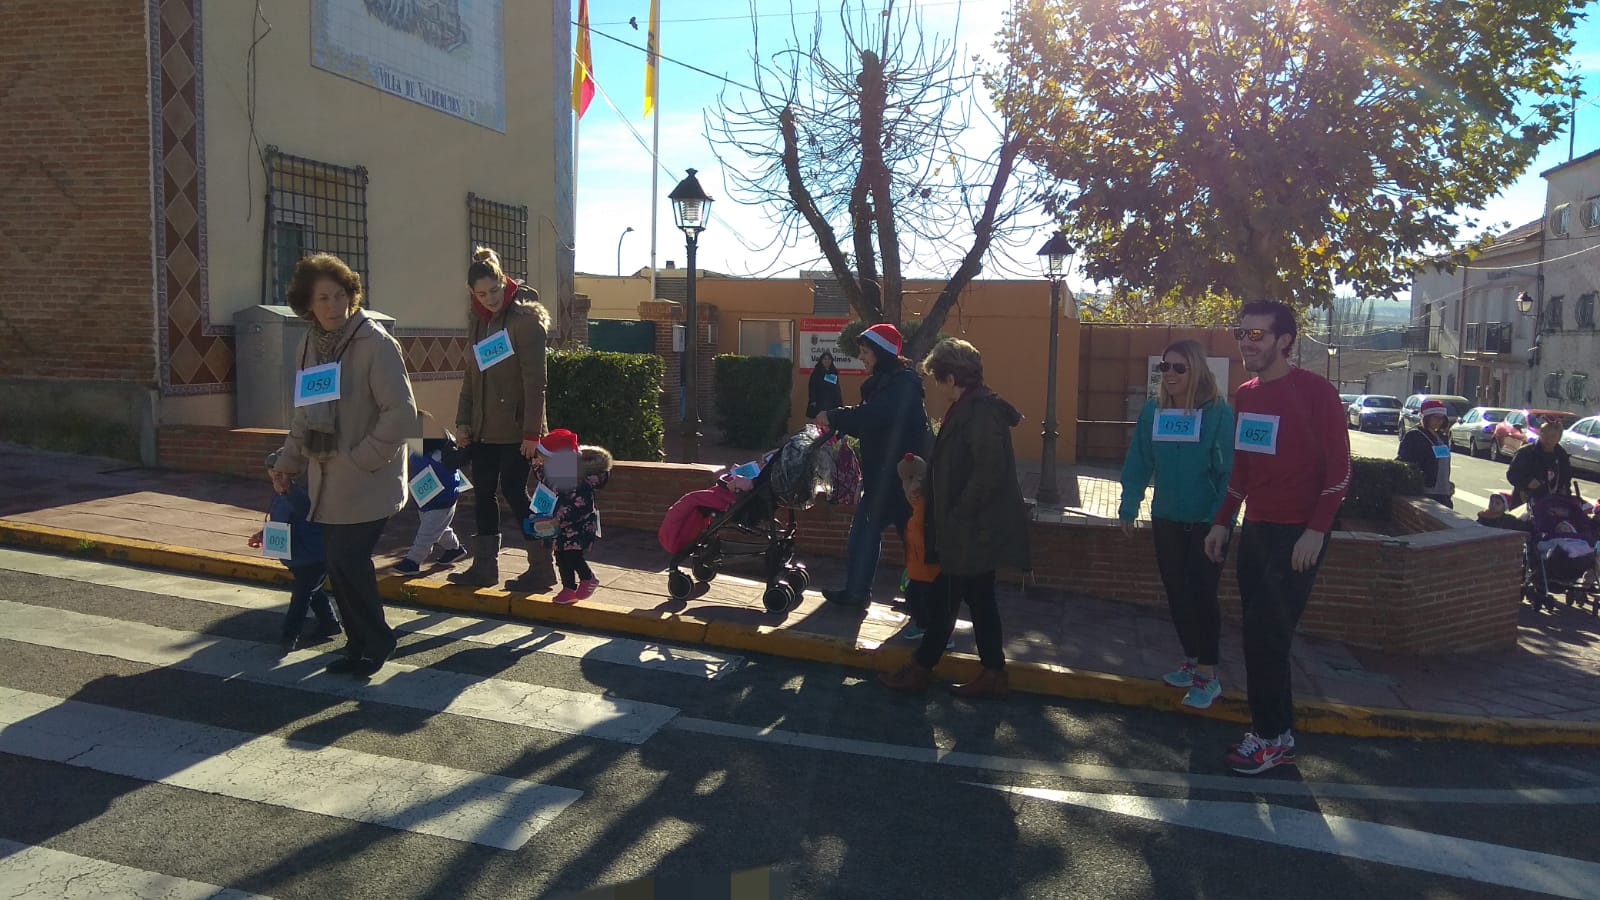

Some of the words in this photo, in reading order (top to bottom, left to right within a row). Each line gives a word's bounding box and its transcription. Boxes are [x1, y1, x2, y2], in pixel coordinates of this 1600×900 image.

[378, 66, 402, 94] VILLA
[485, 342, 504, 358] 043
[307, 377, 331, 392] 059
[1165, 421, 1190, 433] 053
[1245, 428, 1268, 441] 057
